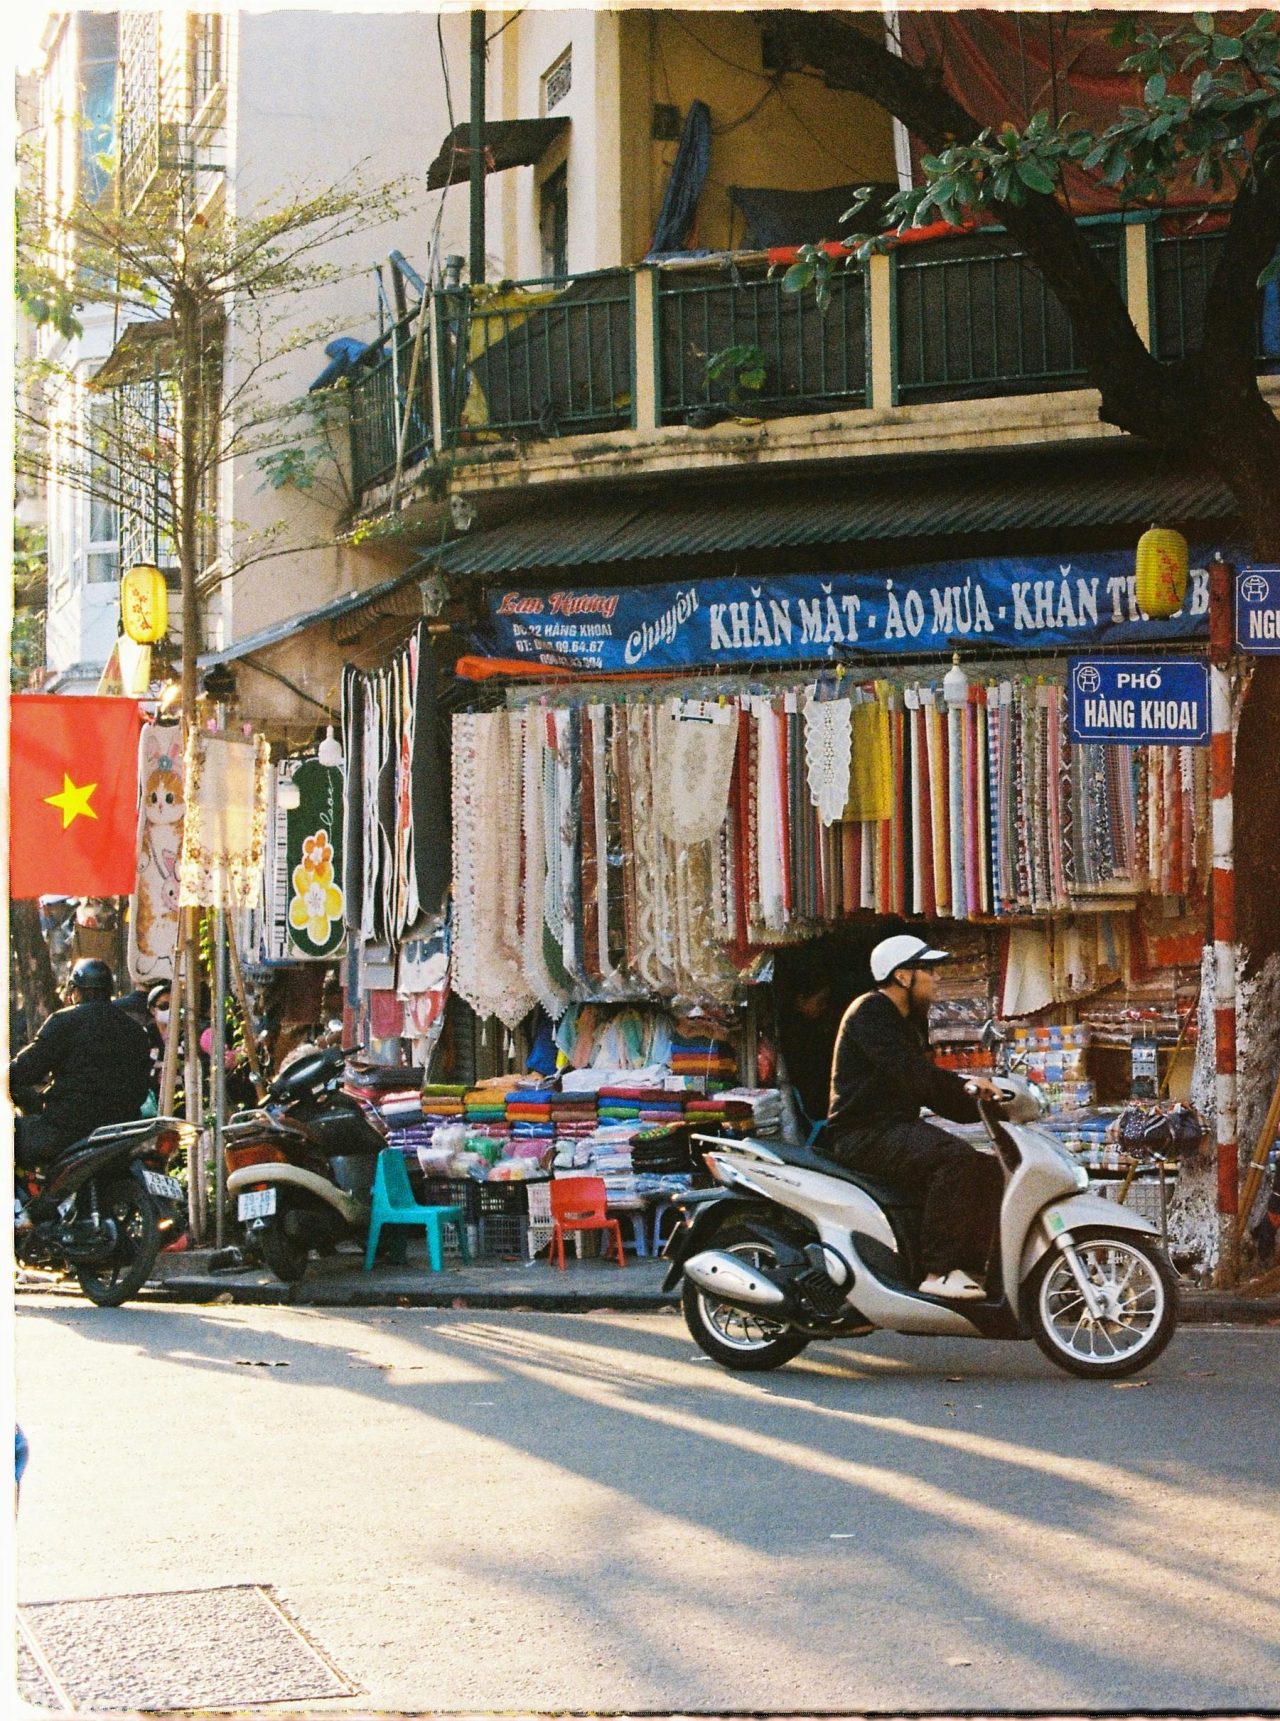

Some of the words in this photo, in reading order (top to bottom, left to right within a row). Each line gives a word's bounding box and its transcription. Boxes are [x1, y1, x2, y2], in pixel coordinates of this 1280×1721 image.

[544, 622, 577, 637] HÀNG
[579, 623, 613, 637] KHOAI
[624, 587, 700, 665] Chuyên
[709, 585, 792, 650] KHĂN
[798, 582, 861, 661] MẶT
[930, 576, 994, 634] MƯA
[1011, 564, 1100, 630] KHĂN
[1117, 668, 1162, 690] PHỐ
[1084, 691, 1134, 729] HÀNG
[1140, 700, 1198, 731] KHOAI
